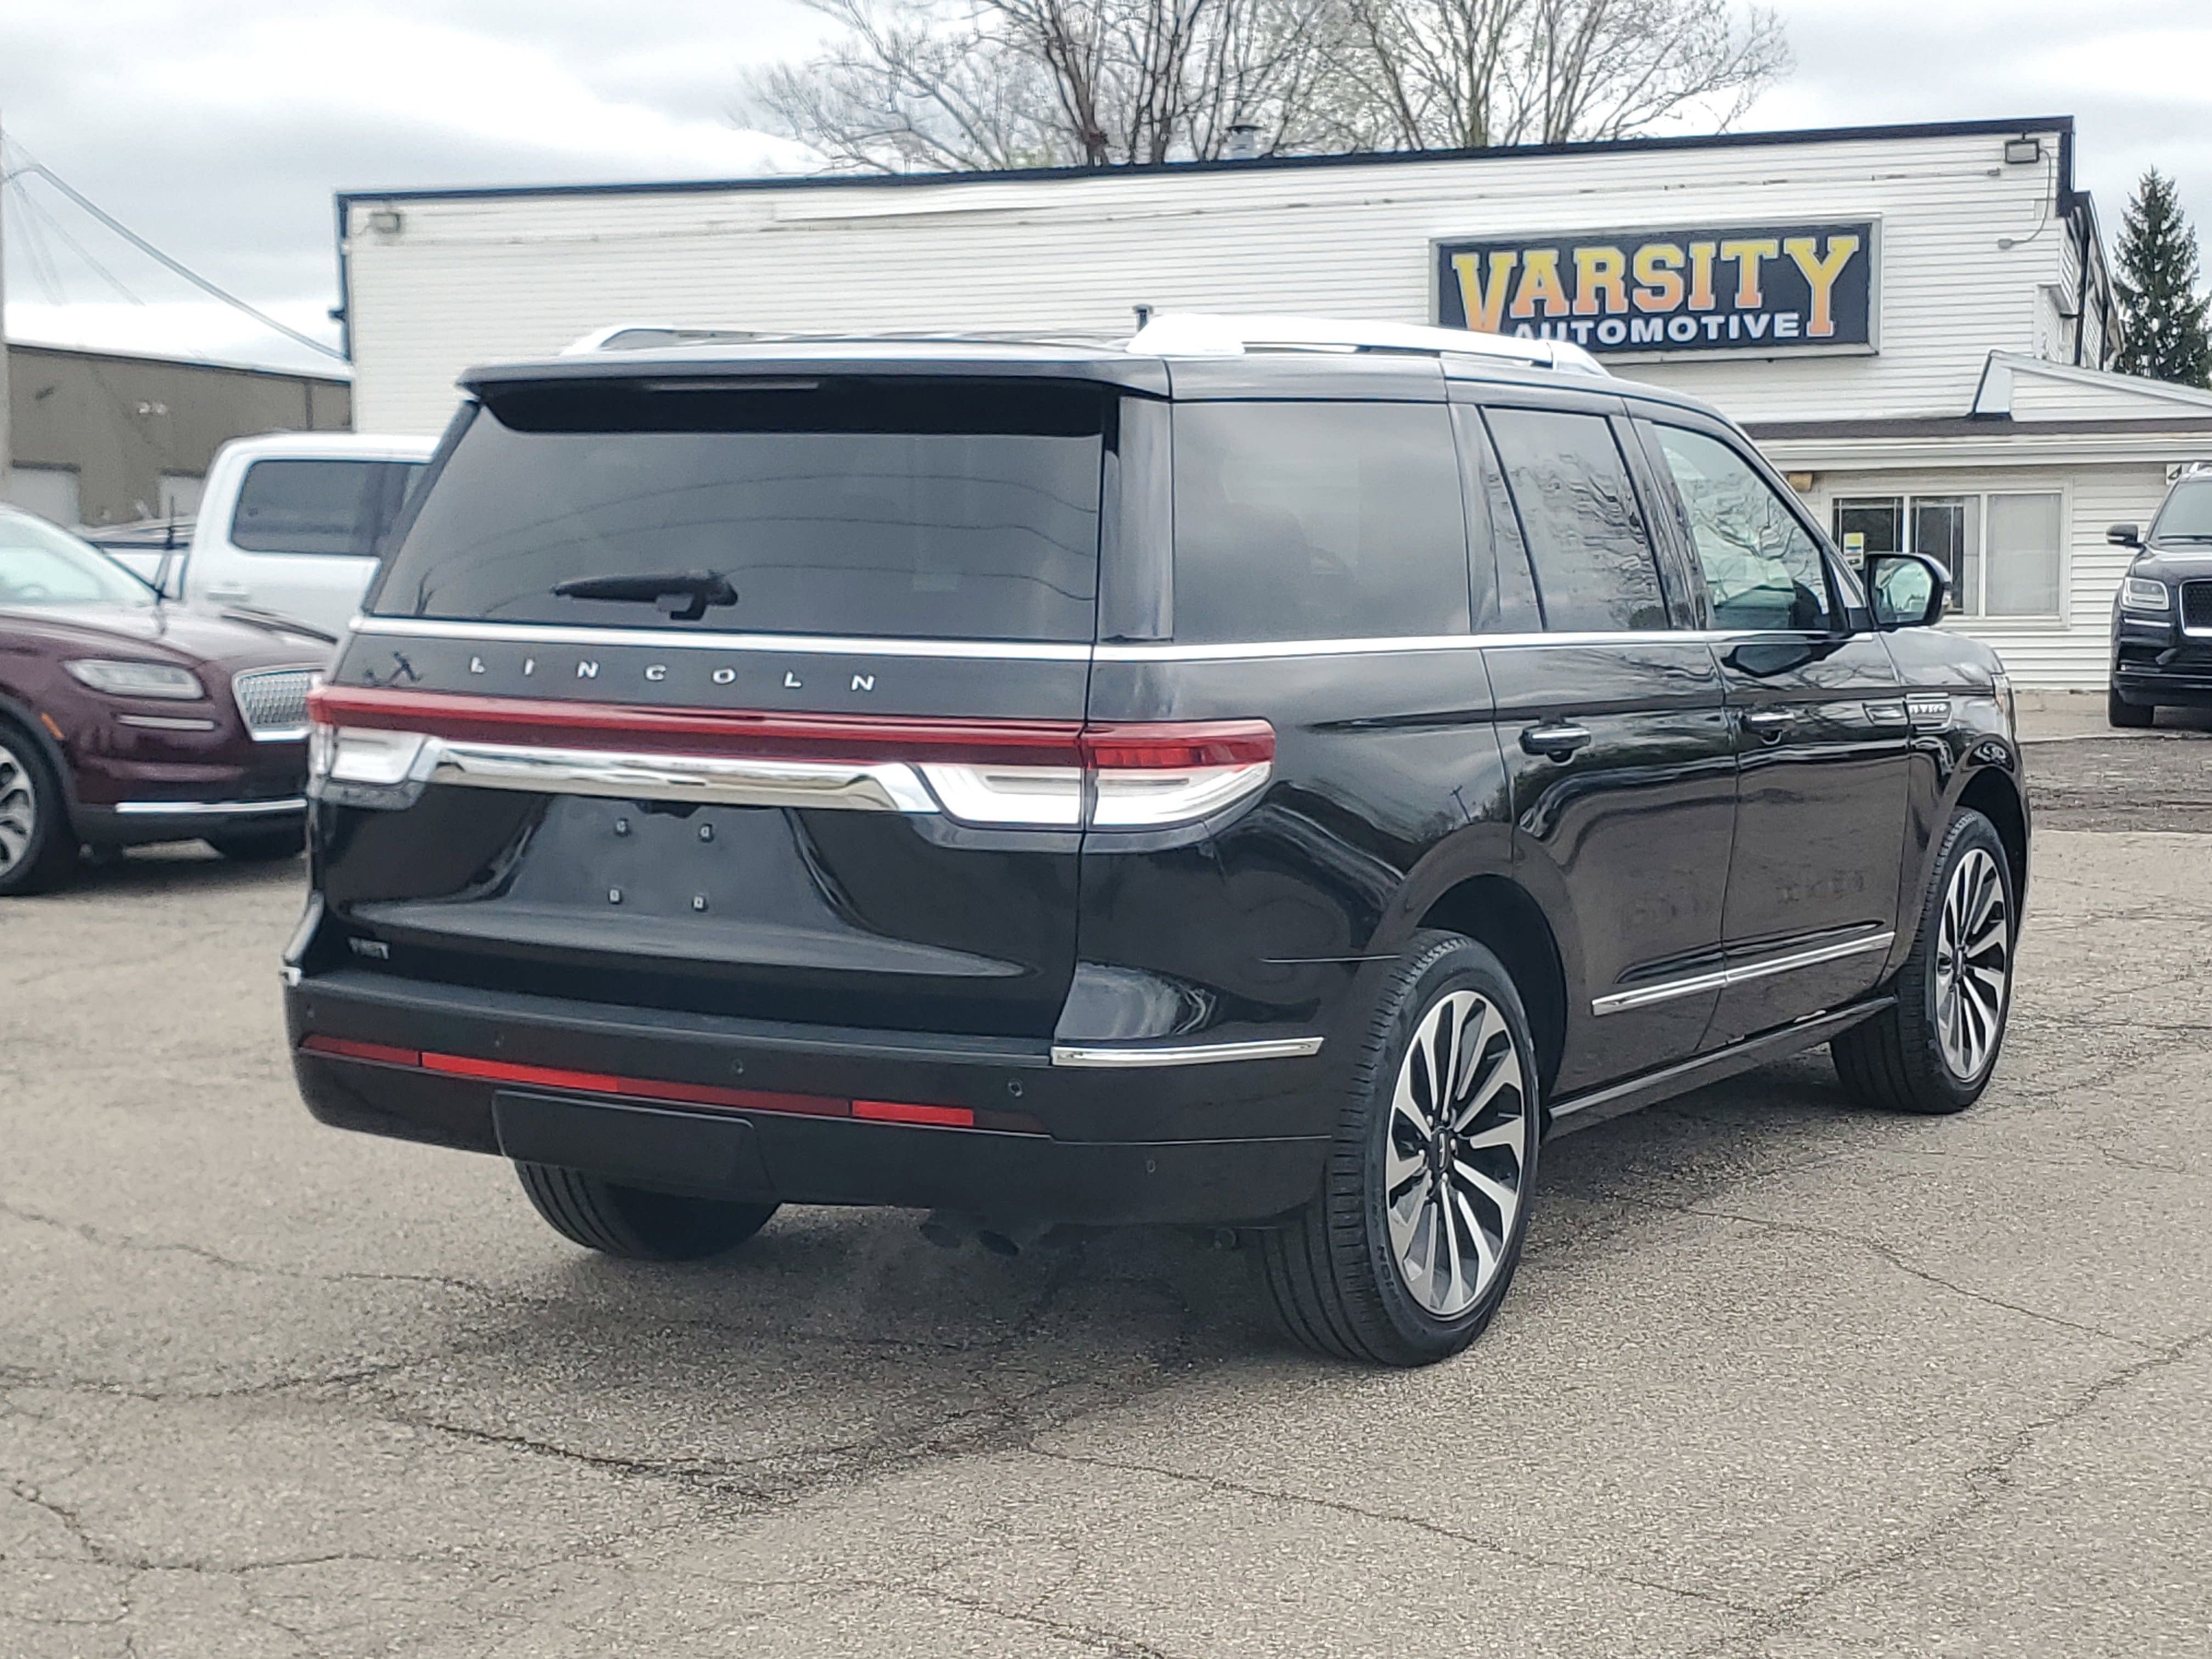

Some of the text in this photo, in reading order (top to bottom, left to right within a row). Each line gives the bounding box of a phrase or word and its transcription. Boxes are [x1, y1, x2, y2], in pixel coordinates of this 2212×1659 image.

[1451, 234, 1860, 337] VARSITY
[1514, 312, 1800, 345] AUTOMOTIVE
[470, 657, 876, 692] LINCOLN
